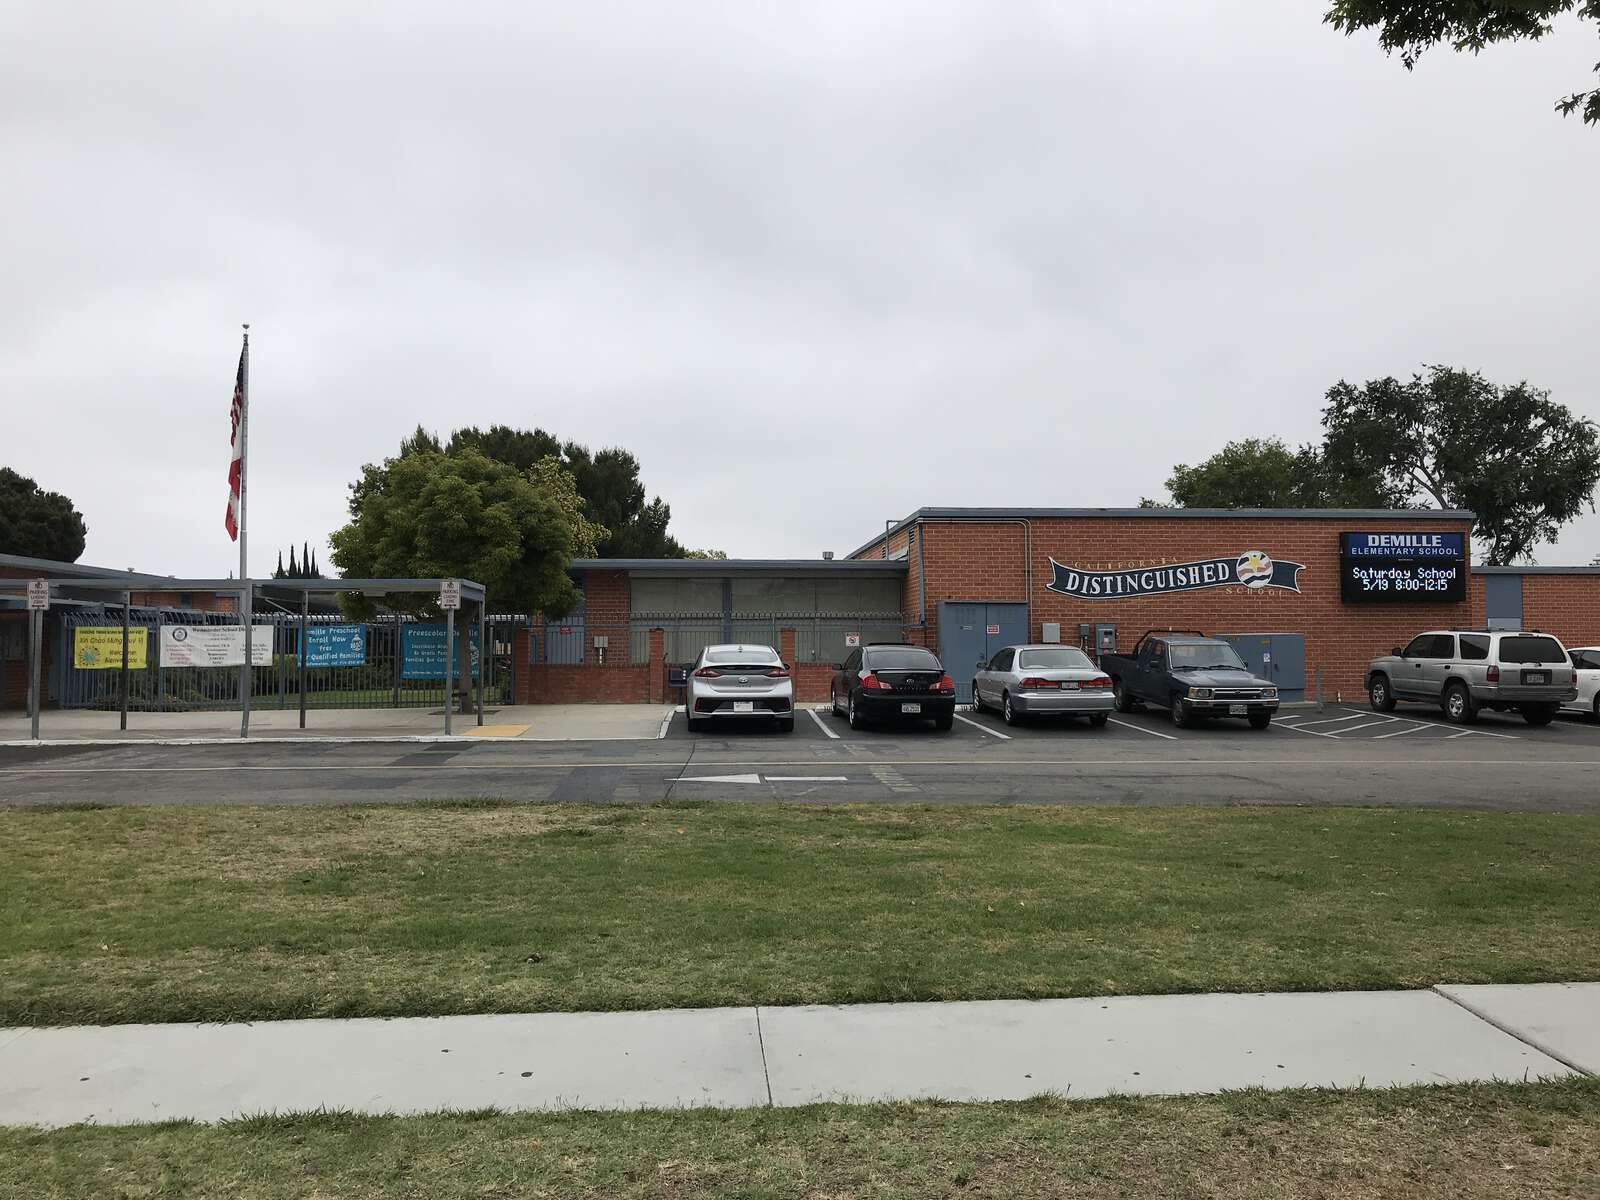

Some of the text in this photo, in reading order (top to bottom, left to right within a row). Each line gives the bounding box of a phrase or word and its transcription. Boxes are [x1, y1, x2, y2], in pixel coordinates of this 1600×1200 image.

[1367, 535, 1442, 547] DEMILLE
[1351, 547, 1458, 555] ELEMENTARY SCHOOL
[1065, 562, 1230, 594] DISTINGUISHED
[1352, 567, 1456, 579] Saturday School
[1362, 579, 1448, 591] 5/19 8:00-12:15
[1225, 587, 1282, 596] SCHOOL
